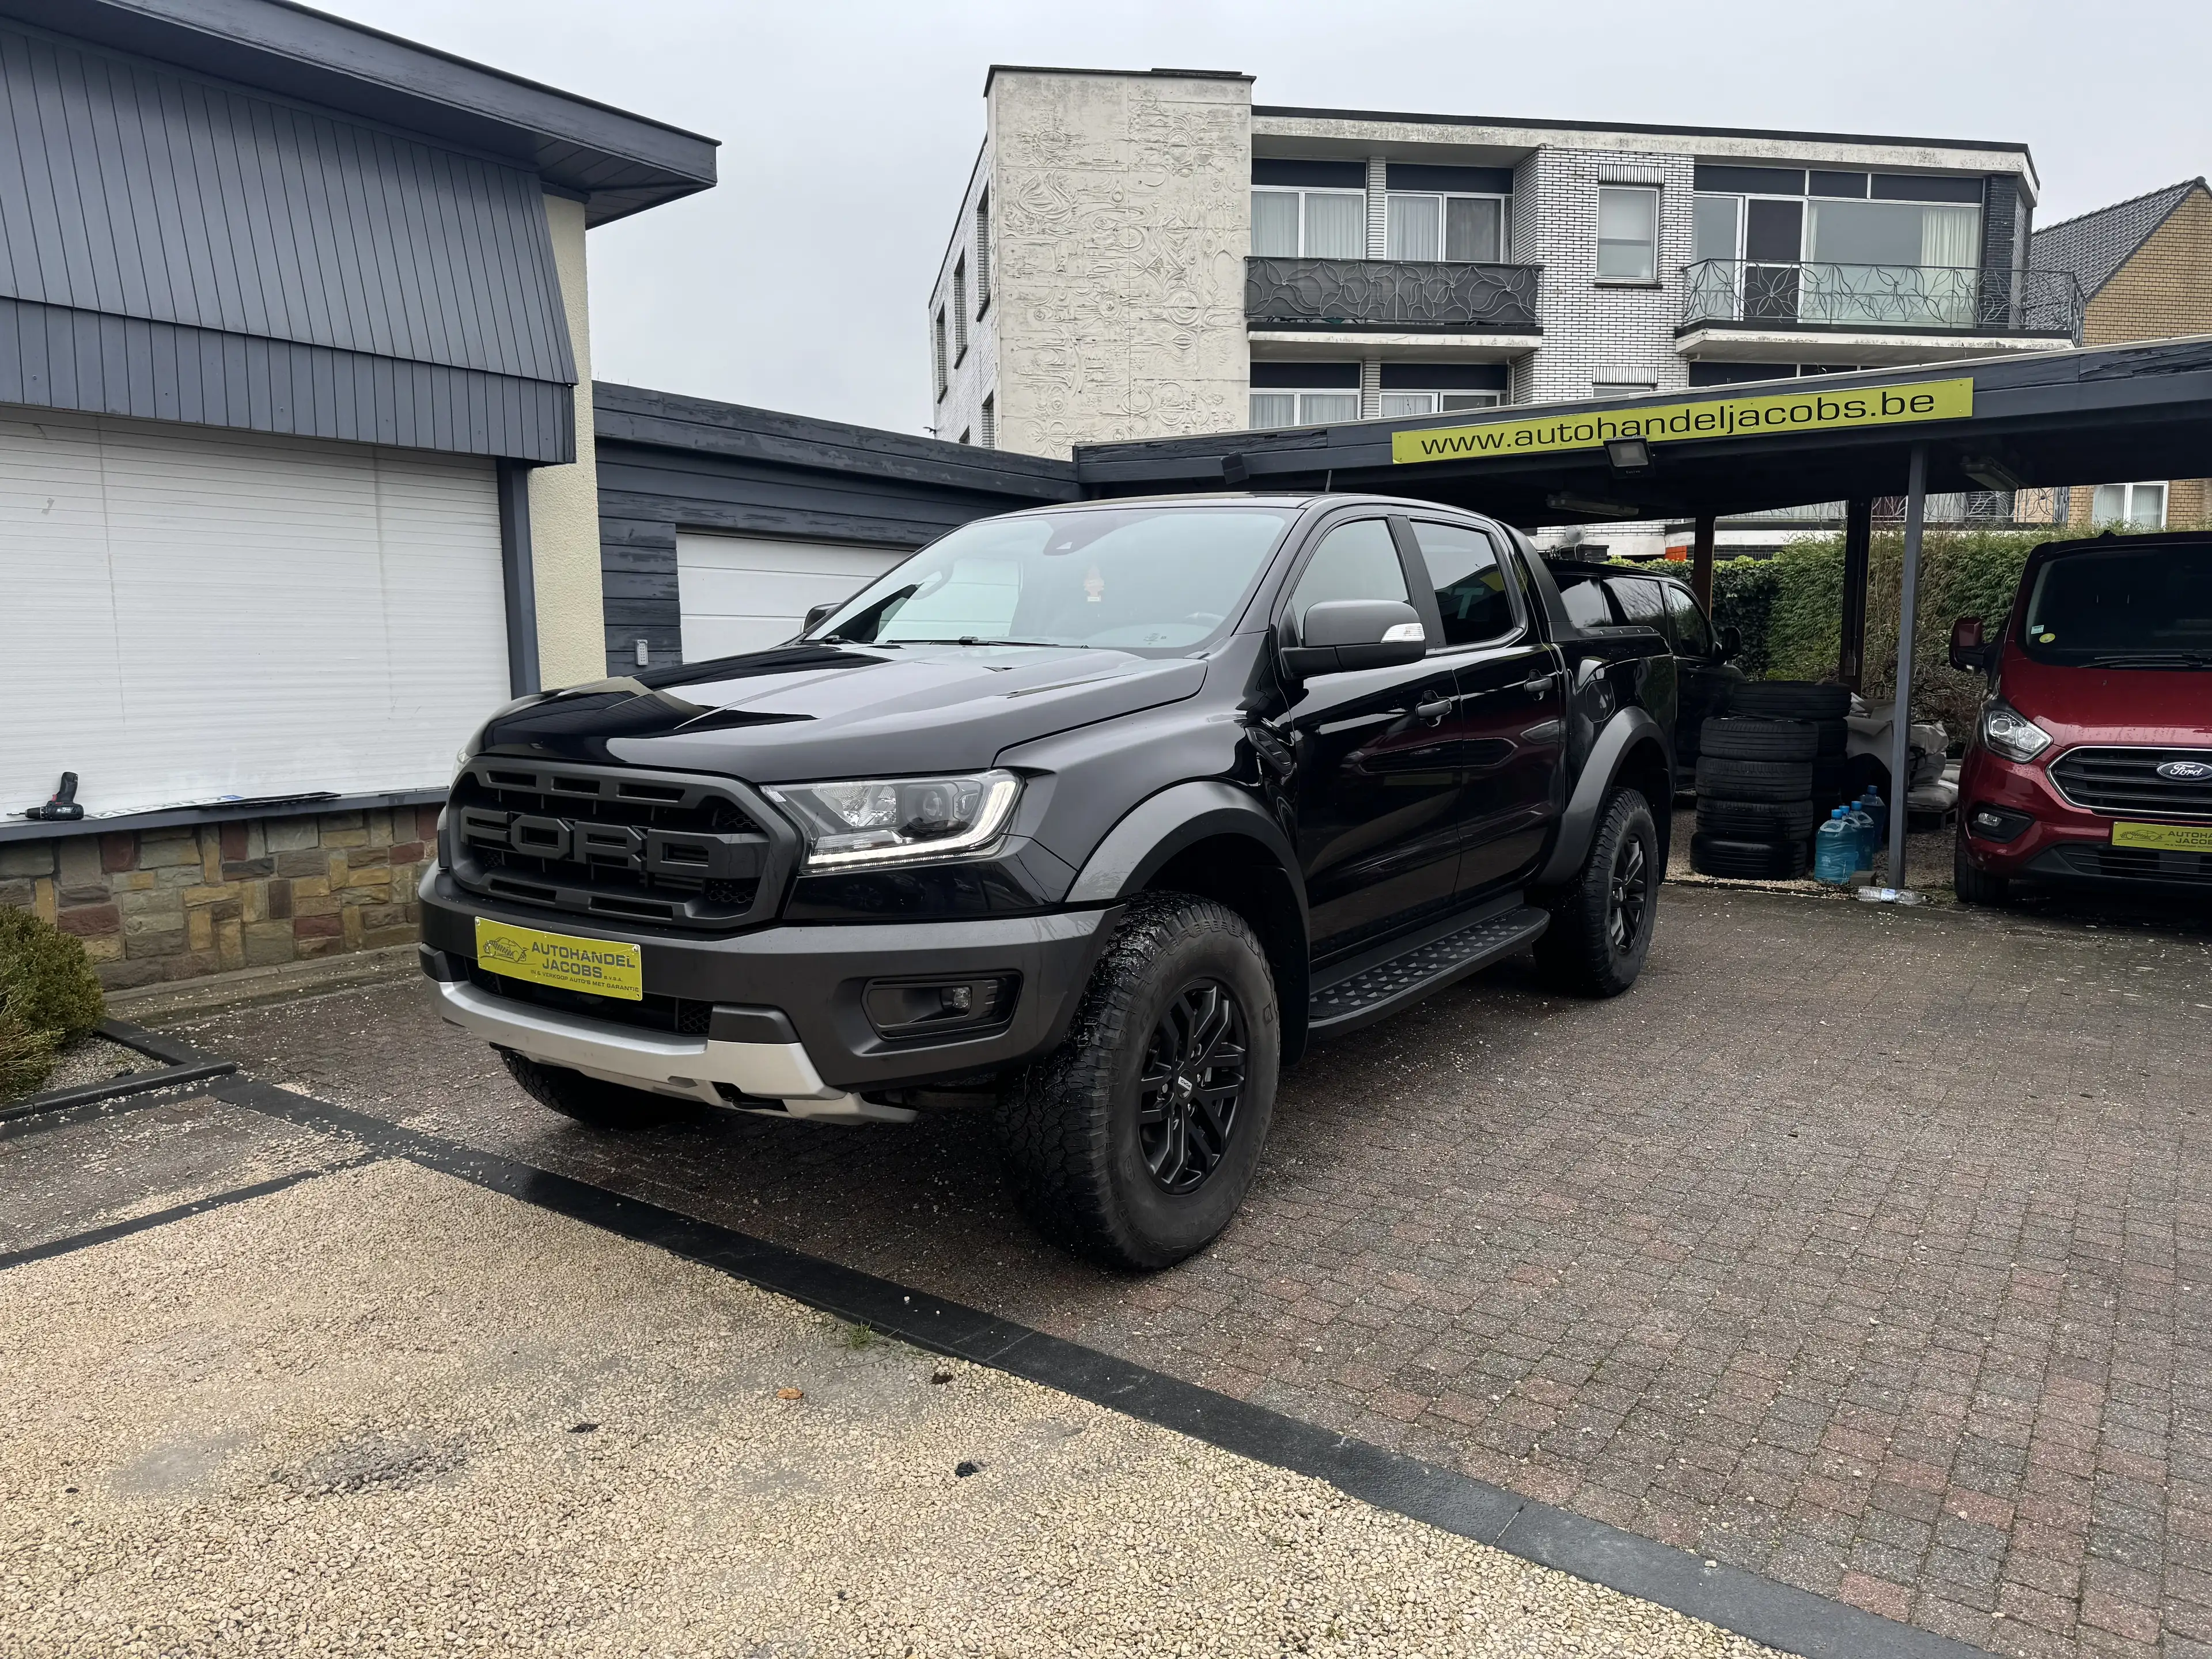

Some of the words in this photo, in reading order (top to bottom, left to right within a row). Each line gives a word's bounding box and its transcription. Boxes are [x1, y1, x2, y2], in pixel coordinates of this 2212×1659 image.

[1421, 392, 1934, 454] www.autohandeljacobs.be
[2170, 764, 2203, 777] Ford
[461, 806, 726, 877] FORD
[532, 941, 635, 968] AUTOHANDEL
[542, 958, 603, 979] JACOBS
[543, 972, 568, 980] VERKOOP
[607, 983, 639, 992] GARANTIE
